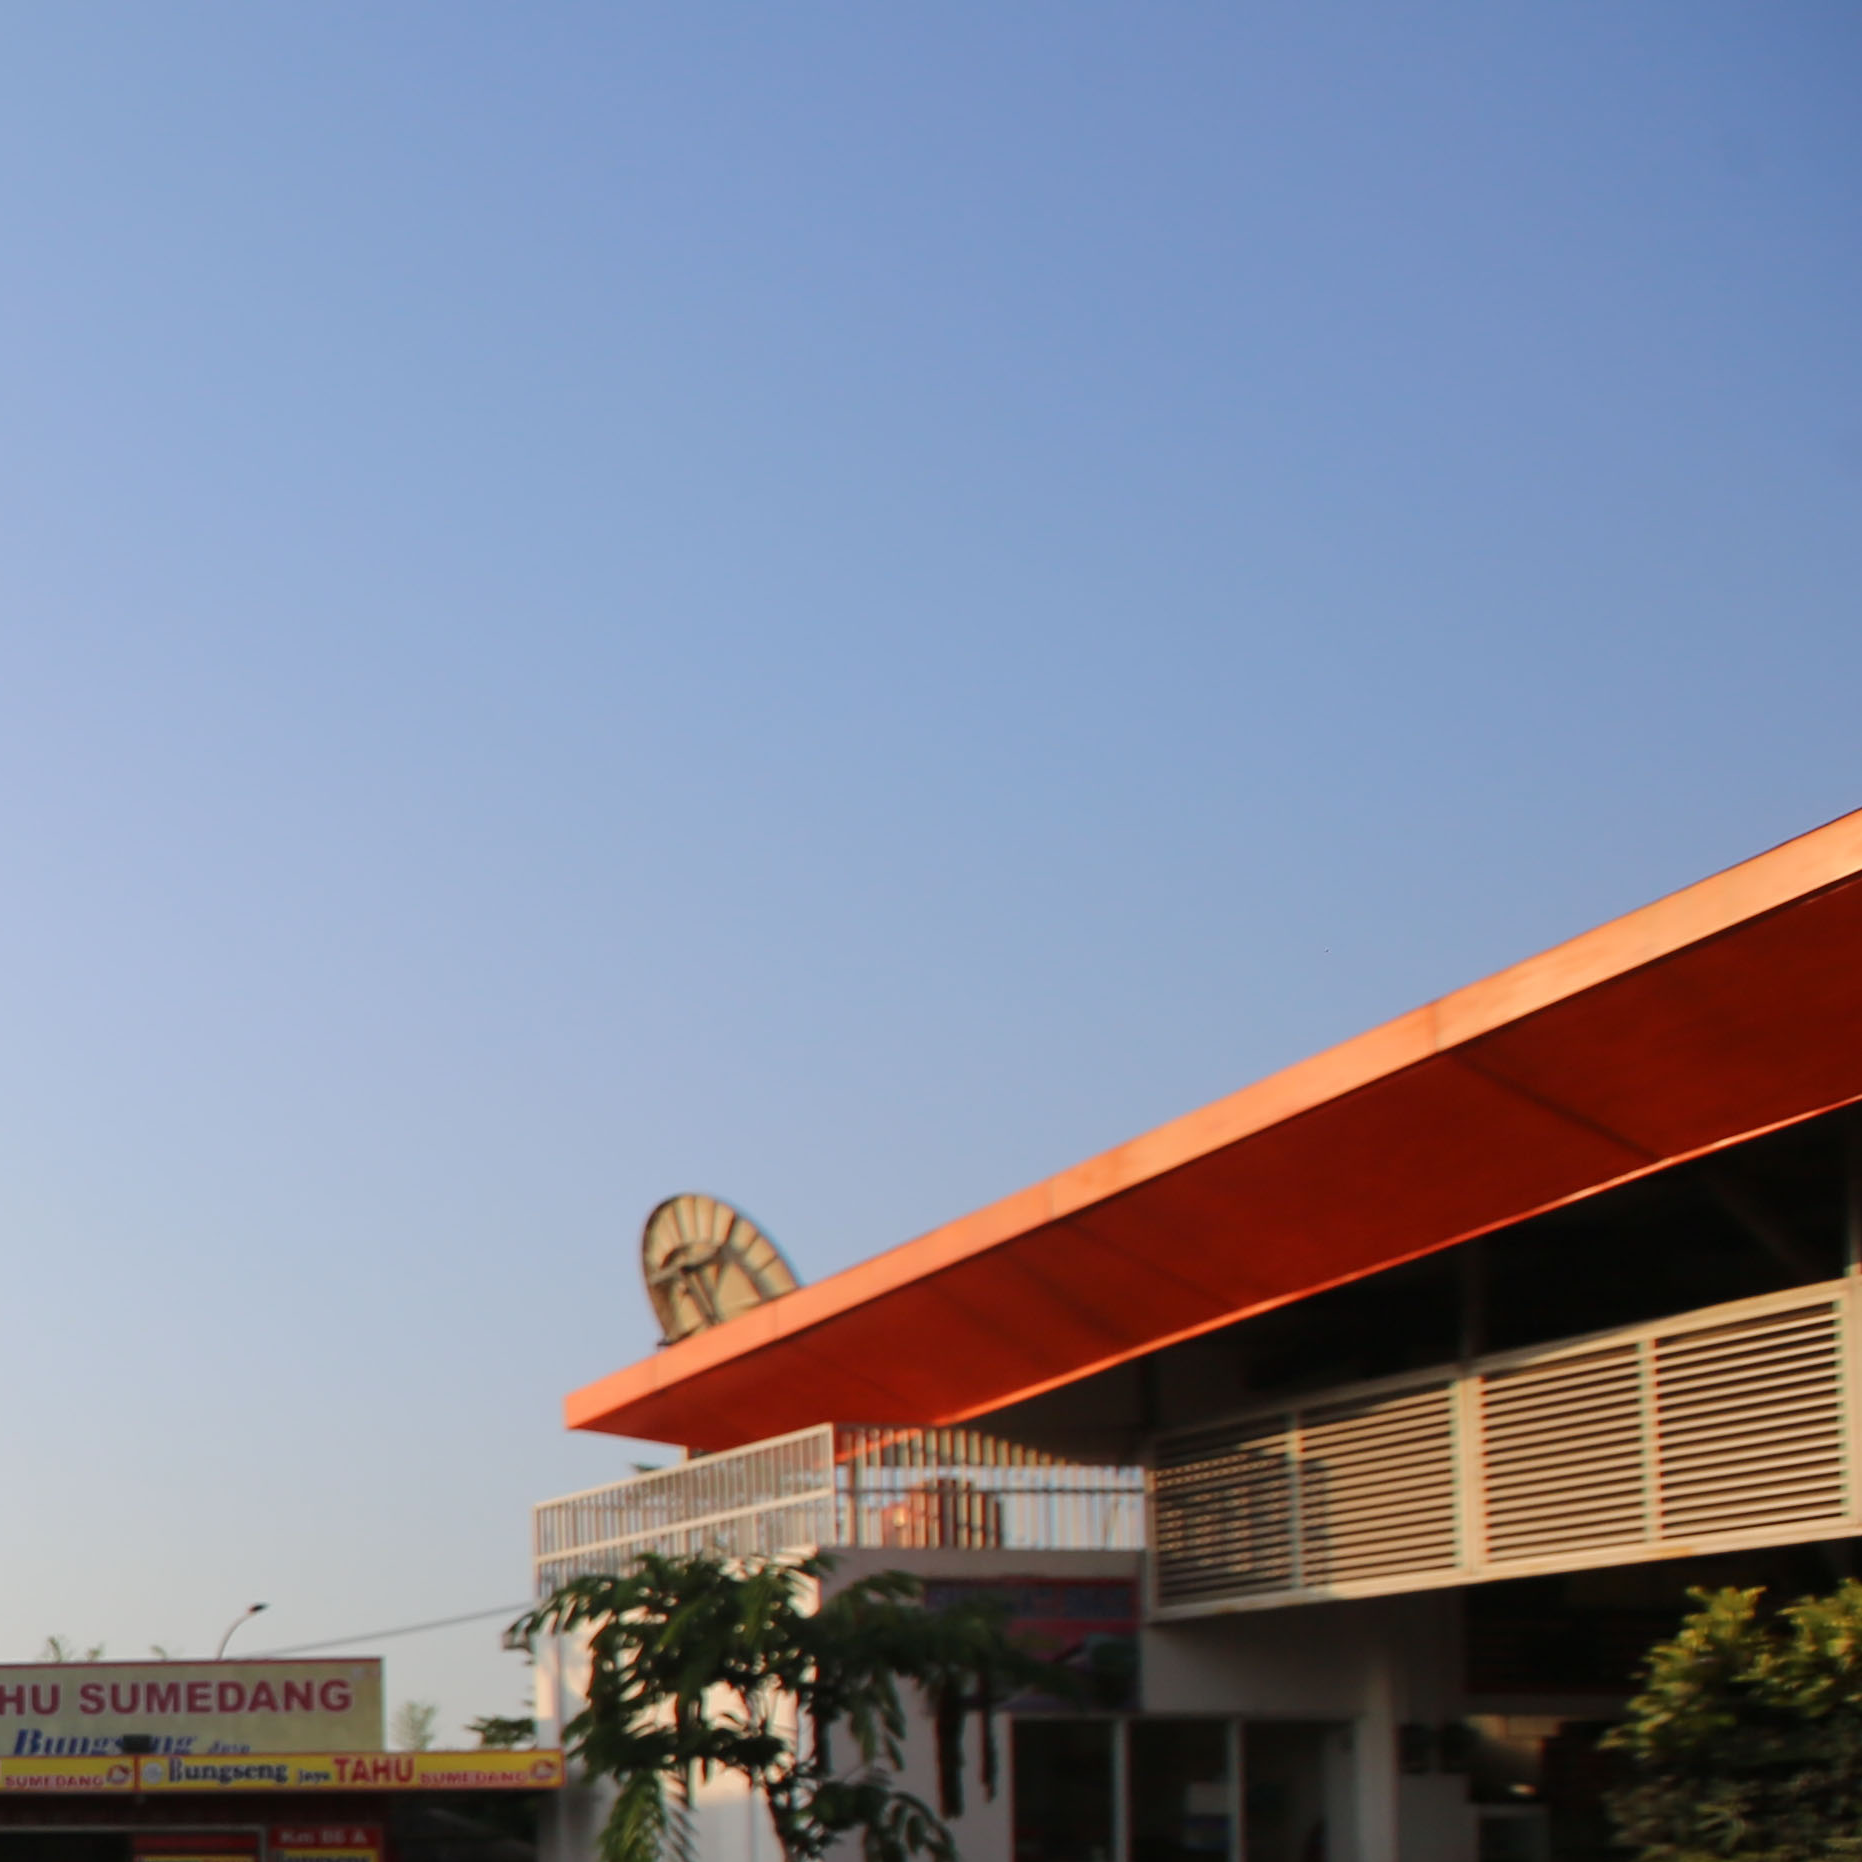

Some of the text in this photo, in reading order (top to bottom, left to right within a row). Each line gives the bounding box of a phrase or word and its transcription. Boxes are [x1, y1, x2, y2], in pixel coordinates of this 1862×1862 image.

[79, 1677, 354, 1715] SUMEDANG
[168, 1757, 288, 1783] Bungseng
[333, 1757, 415, 1784] TAHU
[419, 1771, 528, 1784] SUMEDANG
[5, 1775, 106, 1787] SUMEDANG
[280, 1831, 314, 1843] Km
[352, 1829, 367, 1843] A
